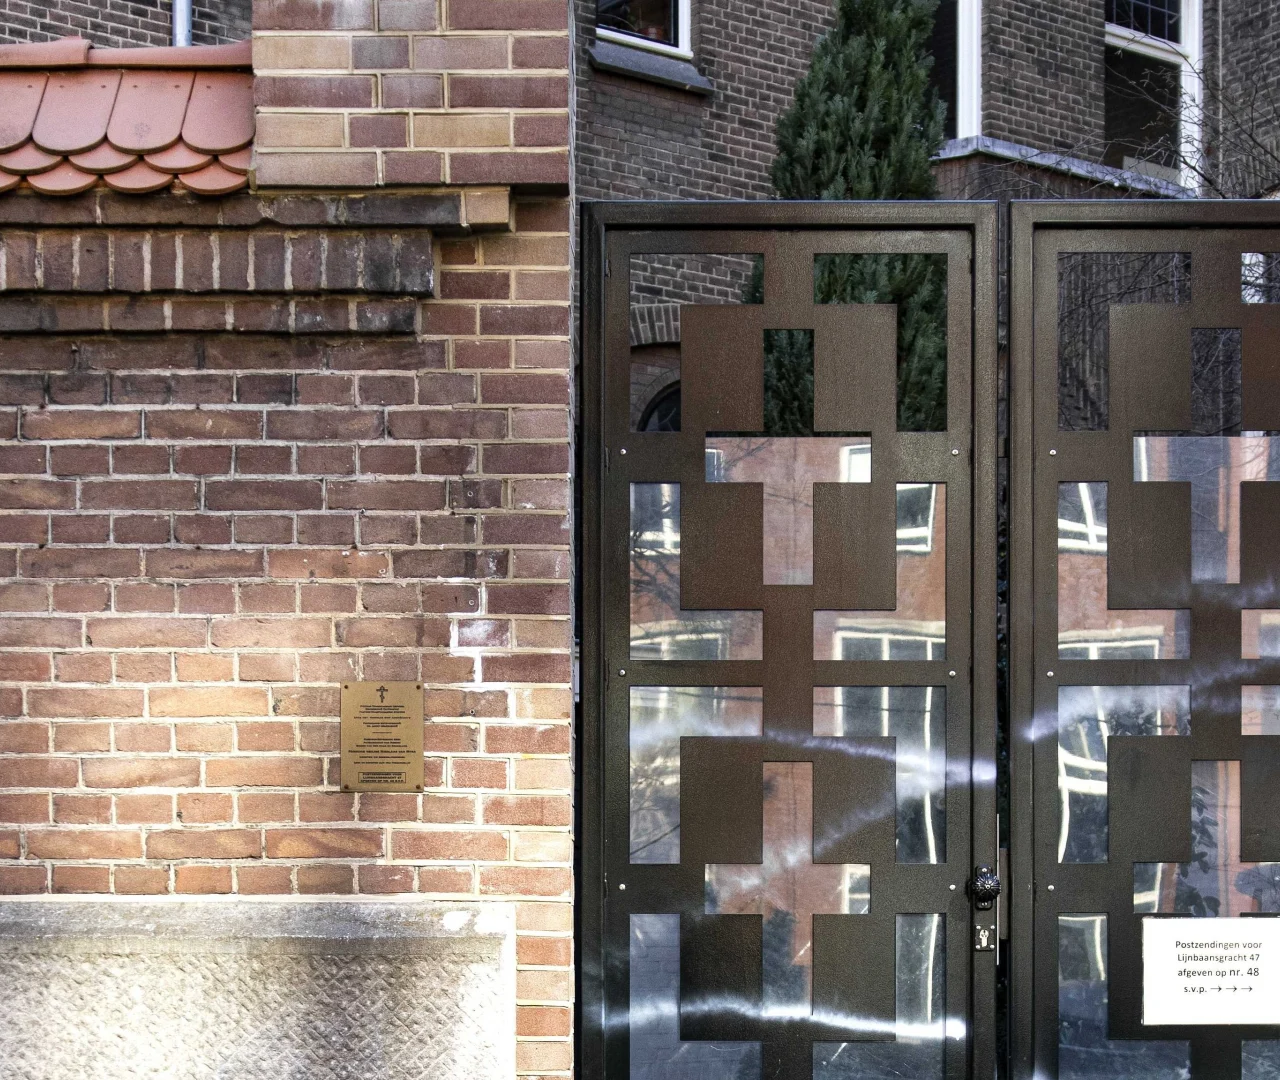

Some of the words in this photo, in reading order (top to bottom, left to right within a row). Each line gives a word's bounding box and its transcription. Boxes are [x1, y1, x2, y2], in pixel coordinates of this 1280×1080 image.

[1175, 940, 1240, 950] Postzendingen
[1177, 953, 1247, 963] Lijnbaansgracht
[1249, 953, 1260, 961] 47
[1177, 968, 1213, 978] afgeven
[1215, 970, 1227, 978] op
[1229, 969, 1244, 977] nr.
[1246, 967, 1260, 977] 48
[1183, 986, 1208, 994] s.v.p.
